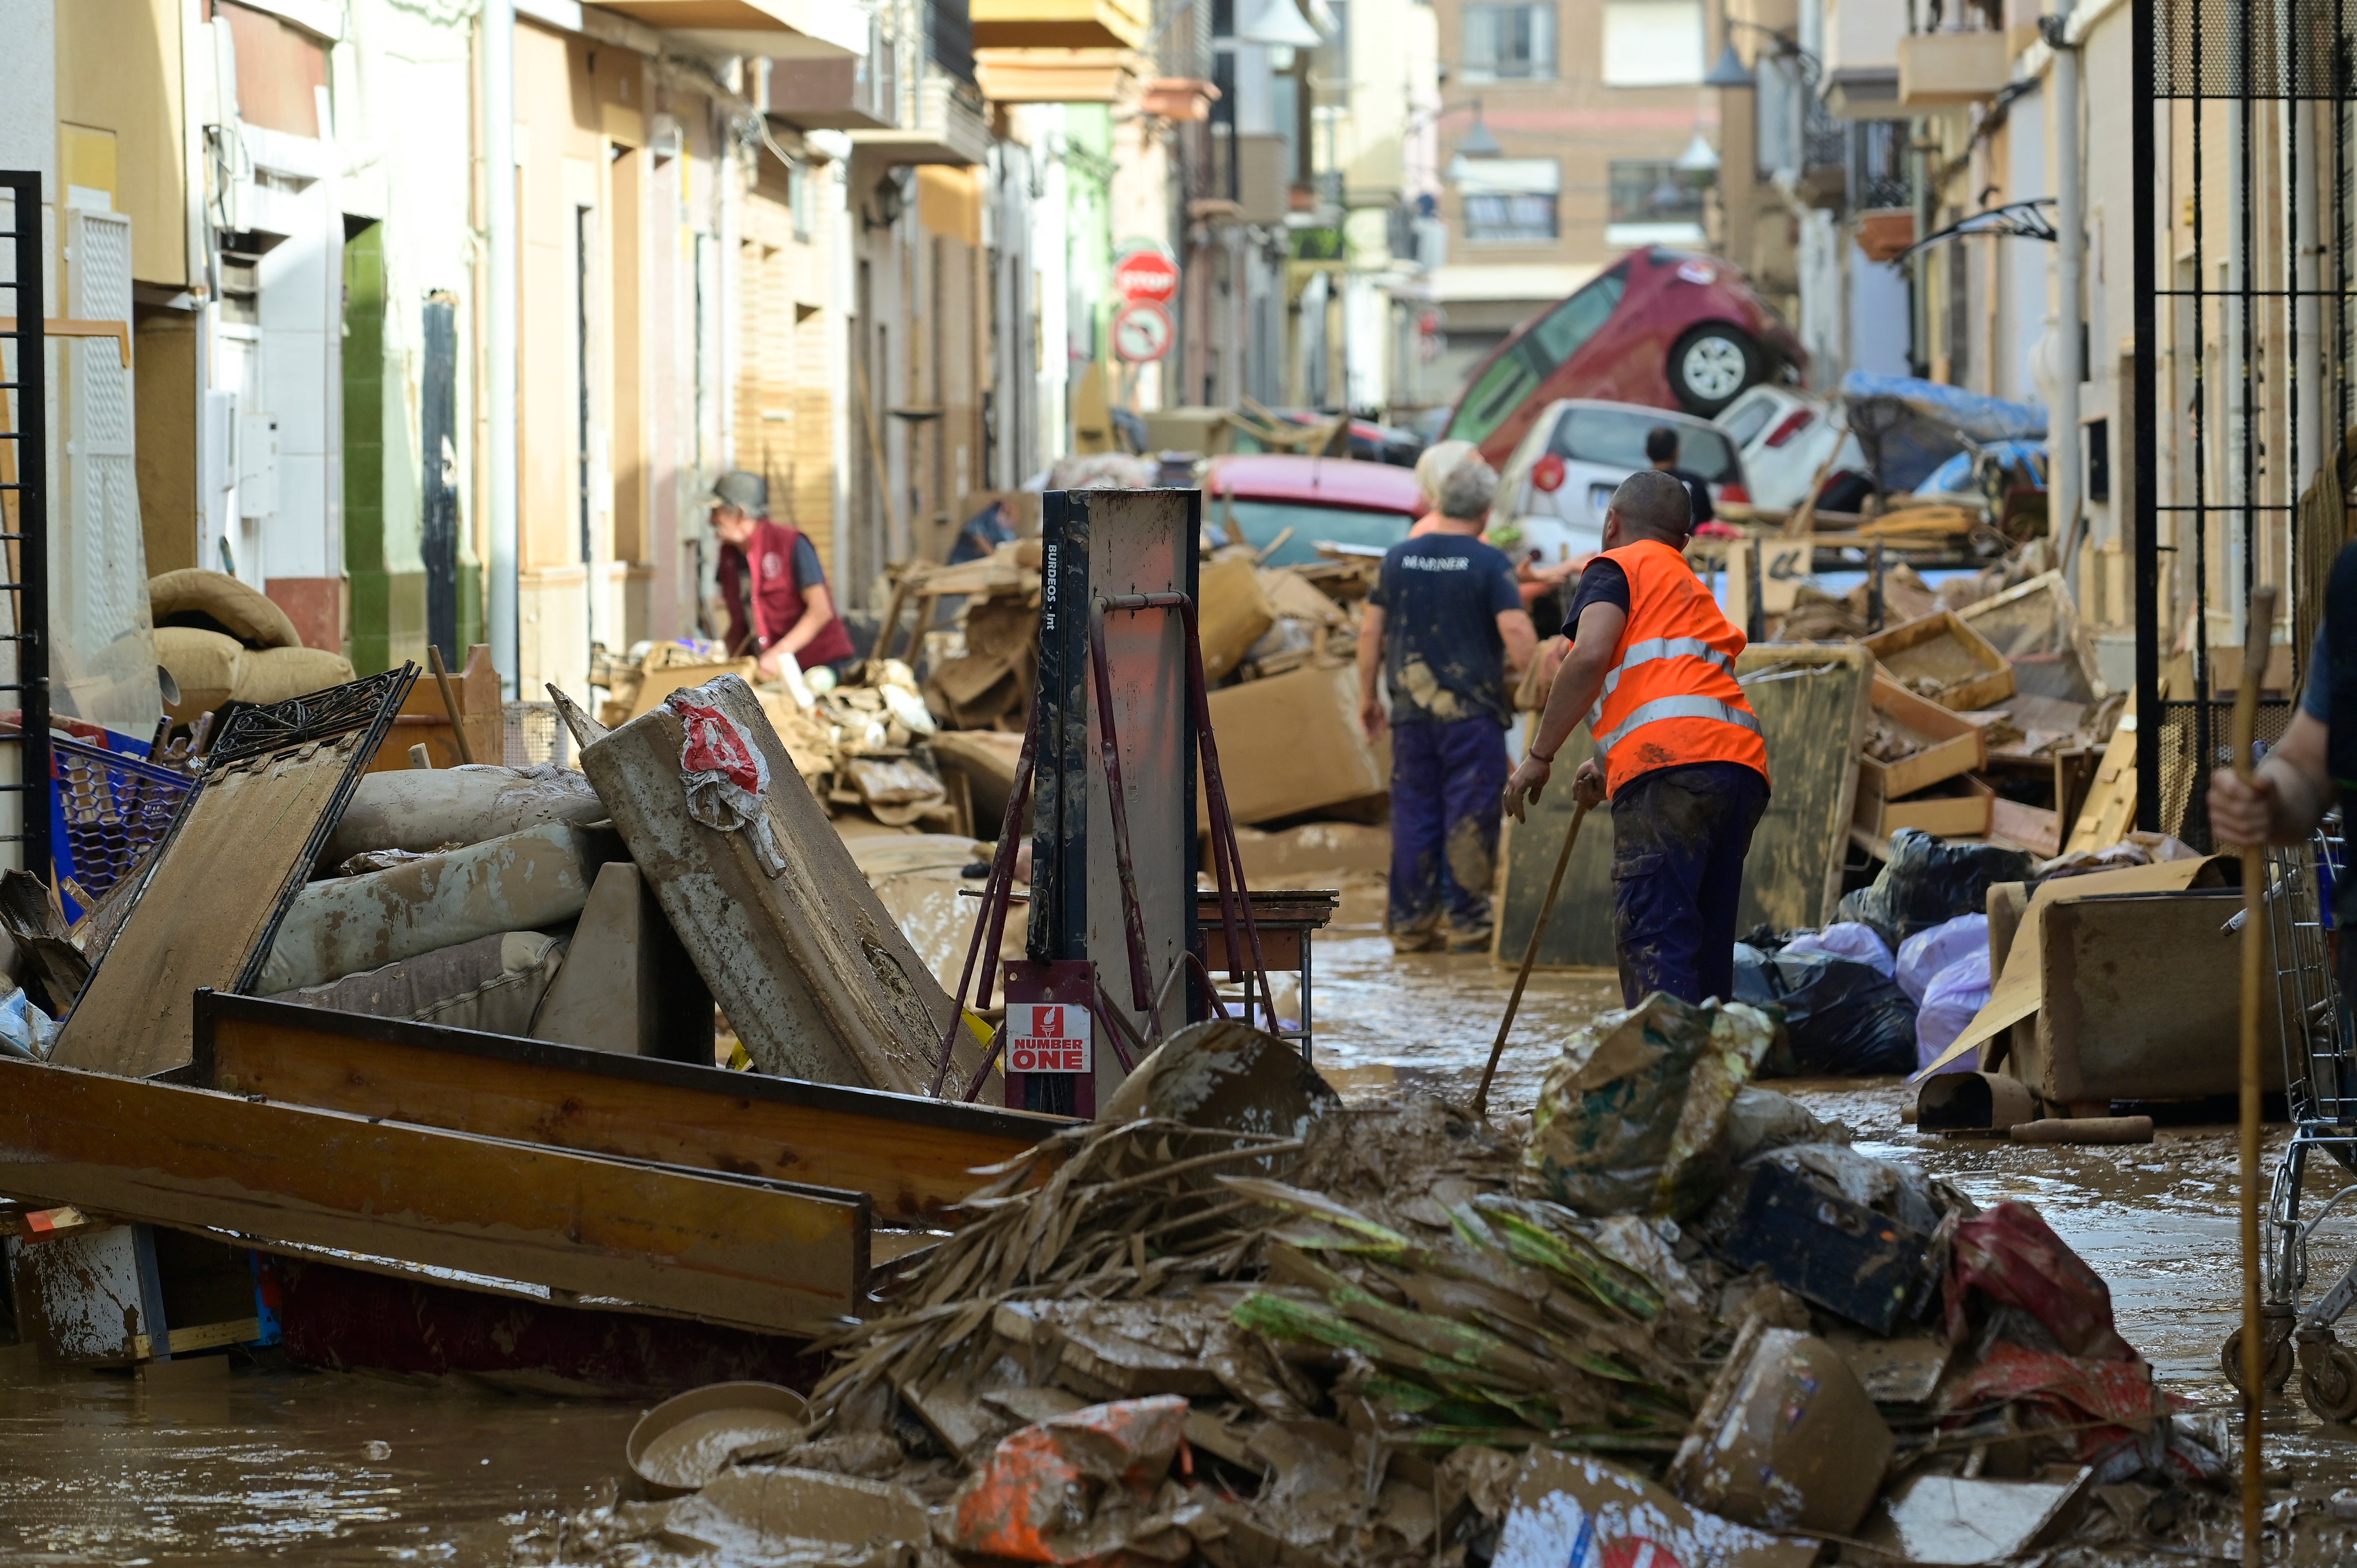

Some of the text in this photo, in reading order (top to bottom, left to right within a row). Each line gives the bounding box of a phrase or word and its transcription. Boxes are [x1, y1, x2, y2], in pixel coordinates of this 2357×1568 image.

[1122, 270, 1174, 291] STOP
[1047, 544, 1057, 602] BURDEOS
[1046, 613, 1055, 630] Int
[1015, 1039, 1083, 1049] NUMBER
[1012, 1050, 1083, 1070] ONE
